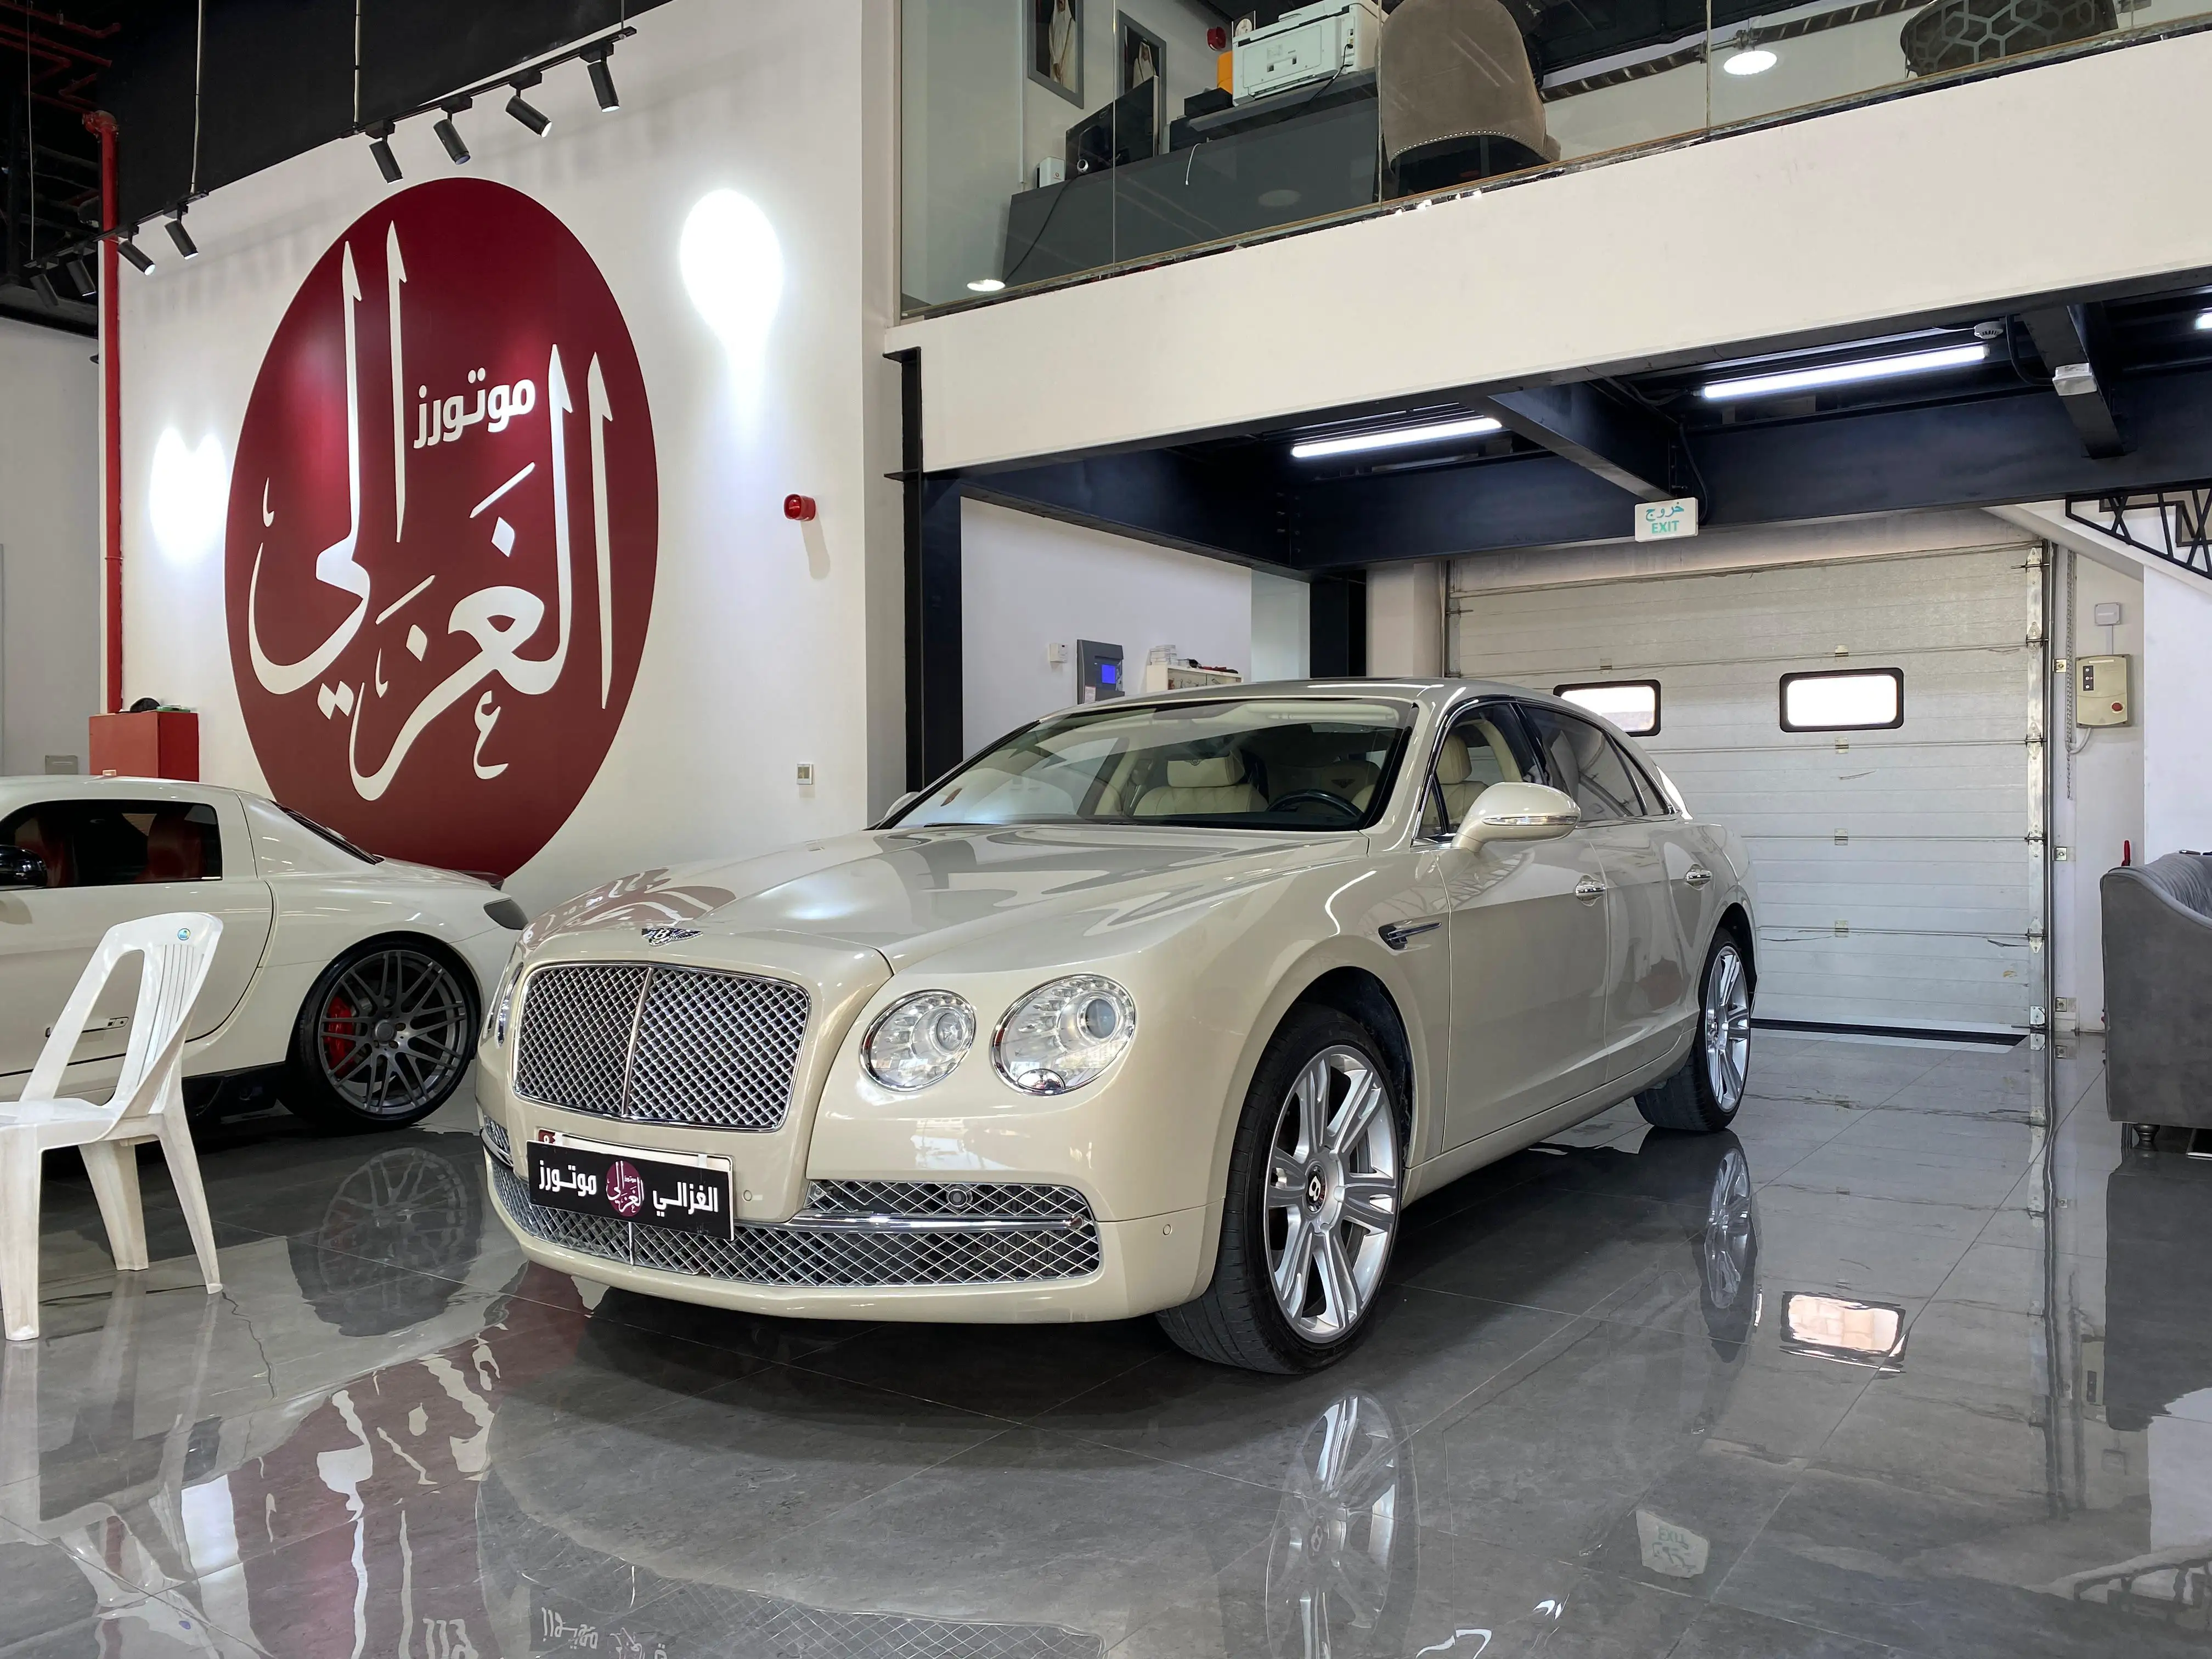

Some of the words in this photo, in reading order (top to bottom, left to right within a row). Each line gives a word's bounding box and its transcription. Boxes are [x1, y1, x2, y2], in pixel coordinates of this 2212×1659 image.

[413, 367, 537, 450] موتورز
[1645, 502, 1685, 522] خروج
[1651, 520, 1679, 534] EXIT
[538, 1160, 597, 1197] موتورز
[652, 1181, 718, 1217] الغزالي
